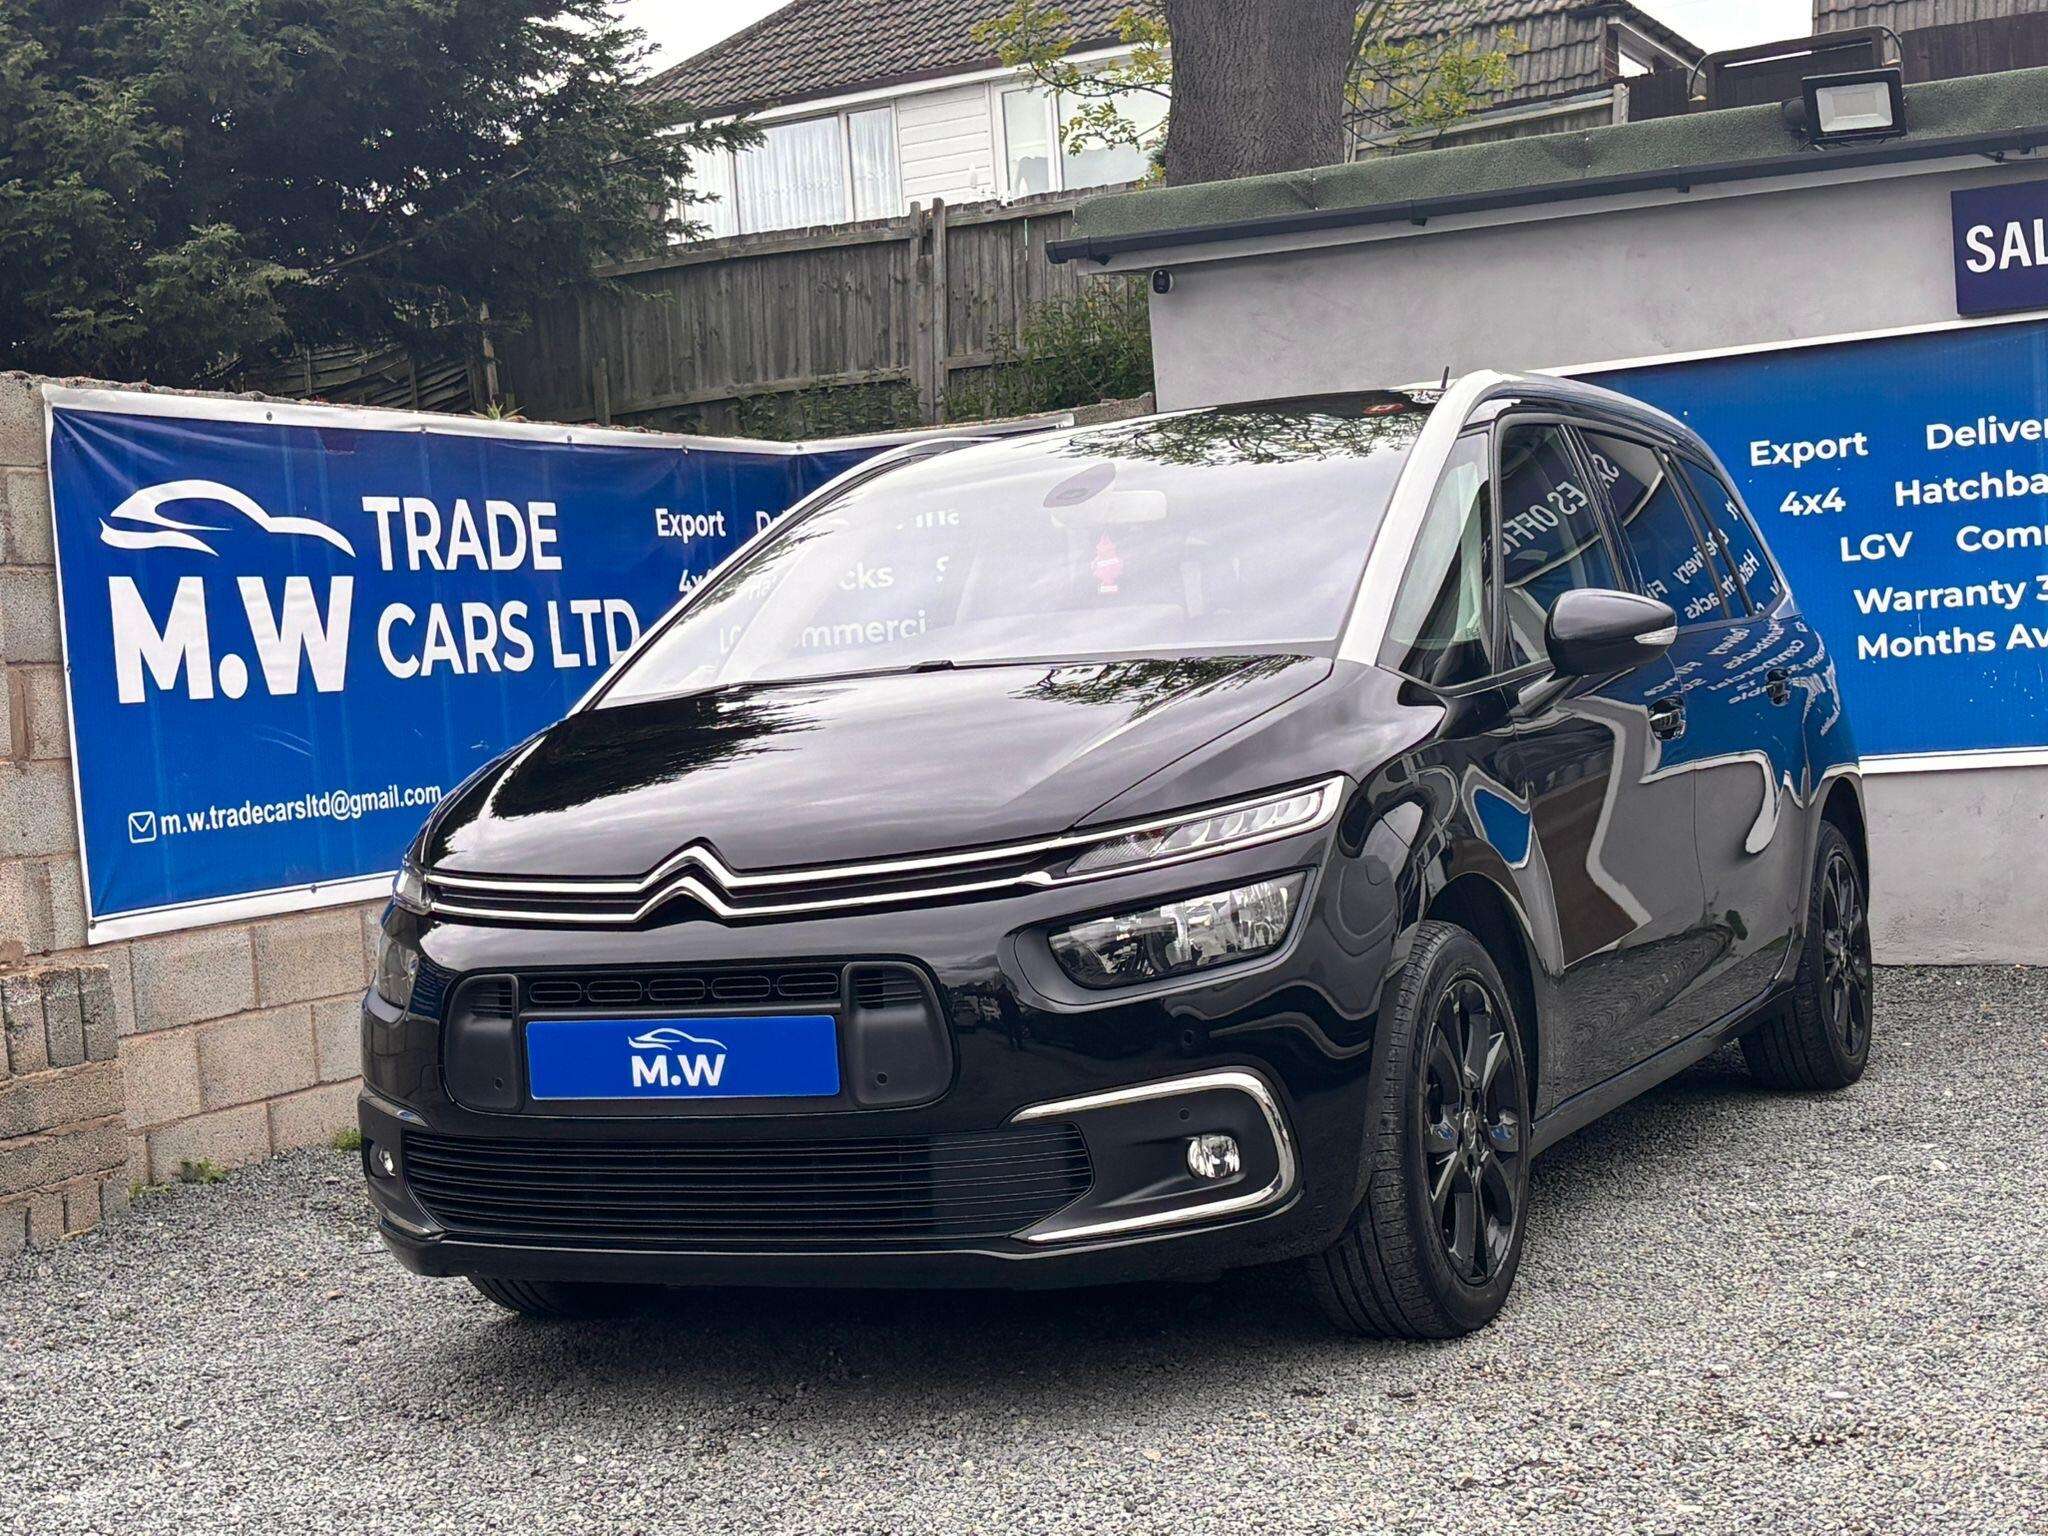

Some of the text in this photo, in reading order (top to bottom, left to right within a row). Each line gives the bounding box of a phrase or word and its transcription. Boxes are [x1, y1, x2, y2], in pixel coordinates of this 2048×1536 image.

[1965, 218, 2048, 273] SAL
[1750, 415, 2048, 468] Export Delive
[1779, 469, 2048, 516] 4x4 Hatchba
[361, 496, 563, 571] TRADE
[655, 508, 727, 544] Export
[1840, 525, 2048, 562] LGV Com
[1853, 580, 2027, 614] Warranty
[109, 575, 354, 704] M.W
[377, 601, 535, 679] CARS
[547, 599, 641, 669] LTD
[1857, 627, 1996, 660] Months
[160, 784, 442, 836] m.w.tradecarsltd@gmail.com
[631, 1054, 726, 1087] M.W
